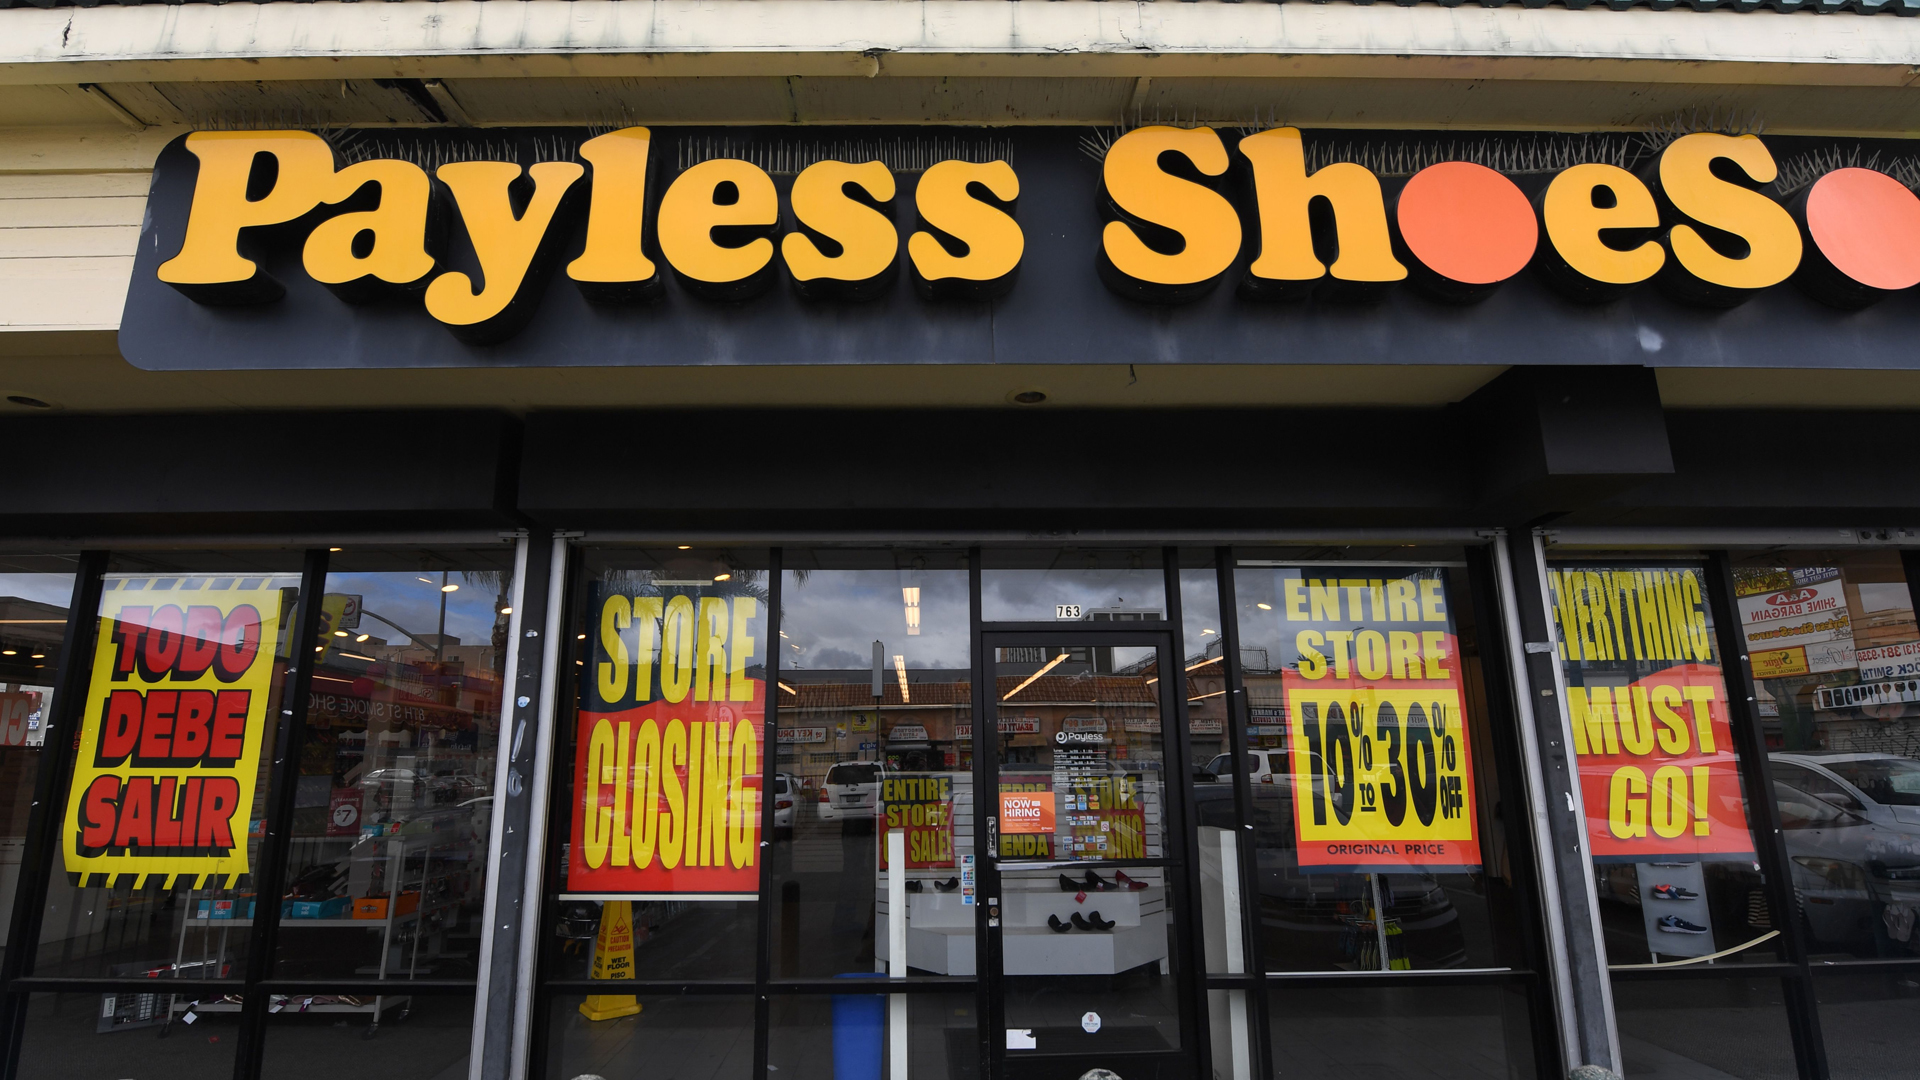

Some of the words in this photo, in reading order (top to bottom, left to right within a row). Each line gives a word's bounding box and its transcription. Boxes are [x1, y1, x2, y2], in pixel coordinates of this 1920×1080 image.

[158, 126, 1025, 325] Payless
[1057, 605, 1080, 617] 763
[1284, 579, 1447, 622] ENTIRE
[112, 604, 262, 683] TODO
[598, 594, 757, 704] STORE
[1295, 630, 1451, 681] STORE
[95, 689, 252, 767] DEBE
[1567, 684, 1717, 756] MUST
[1068, 732, 1104, 743] Payless
[1300, 701, 1373, 826] 10%
[1359, 783, 1376, 807] TO
[1377, 701, 1456, 827] 30%
[1440, 775, 1464, 820] OFF
[583, 717, 757, 870] CLOSING
[883, 777, 949, 801] ENTIRE
[1004, 799, 1031, 809] NOW
[1608, 765, 1711, 839] GO!
[77, 774, 241, 858] SALIR
[336, 809, 352, 822] $7
[886, 803, 949, 828] STORE
[1004, 808, 1041, 818] HIRING
[910, 830, 952, 863] SALE!
[1327, 844, 1399, 855] ORIGINAL
[1405, 844, 1445, 855] PRICE
[610, 935, 630, 944] CAUTION
[607, 962, 630, 970] FLOOR
[611, 956, 627, 964] WET
